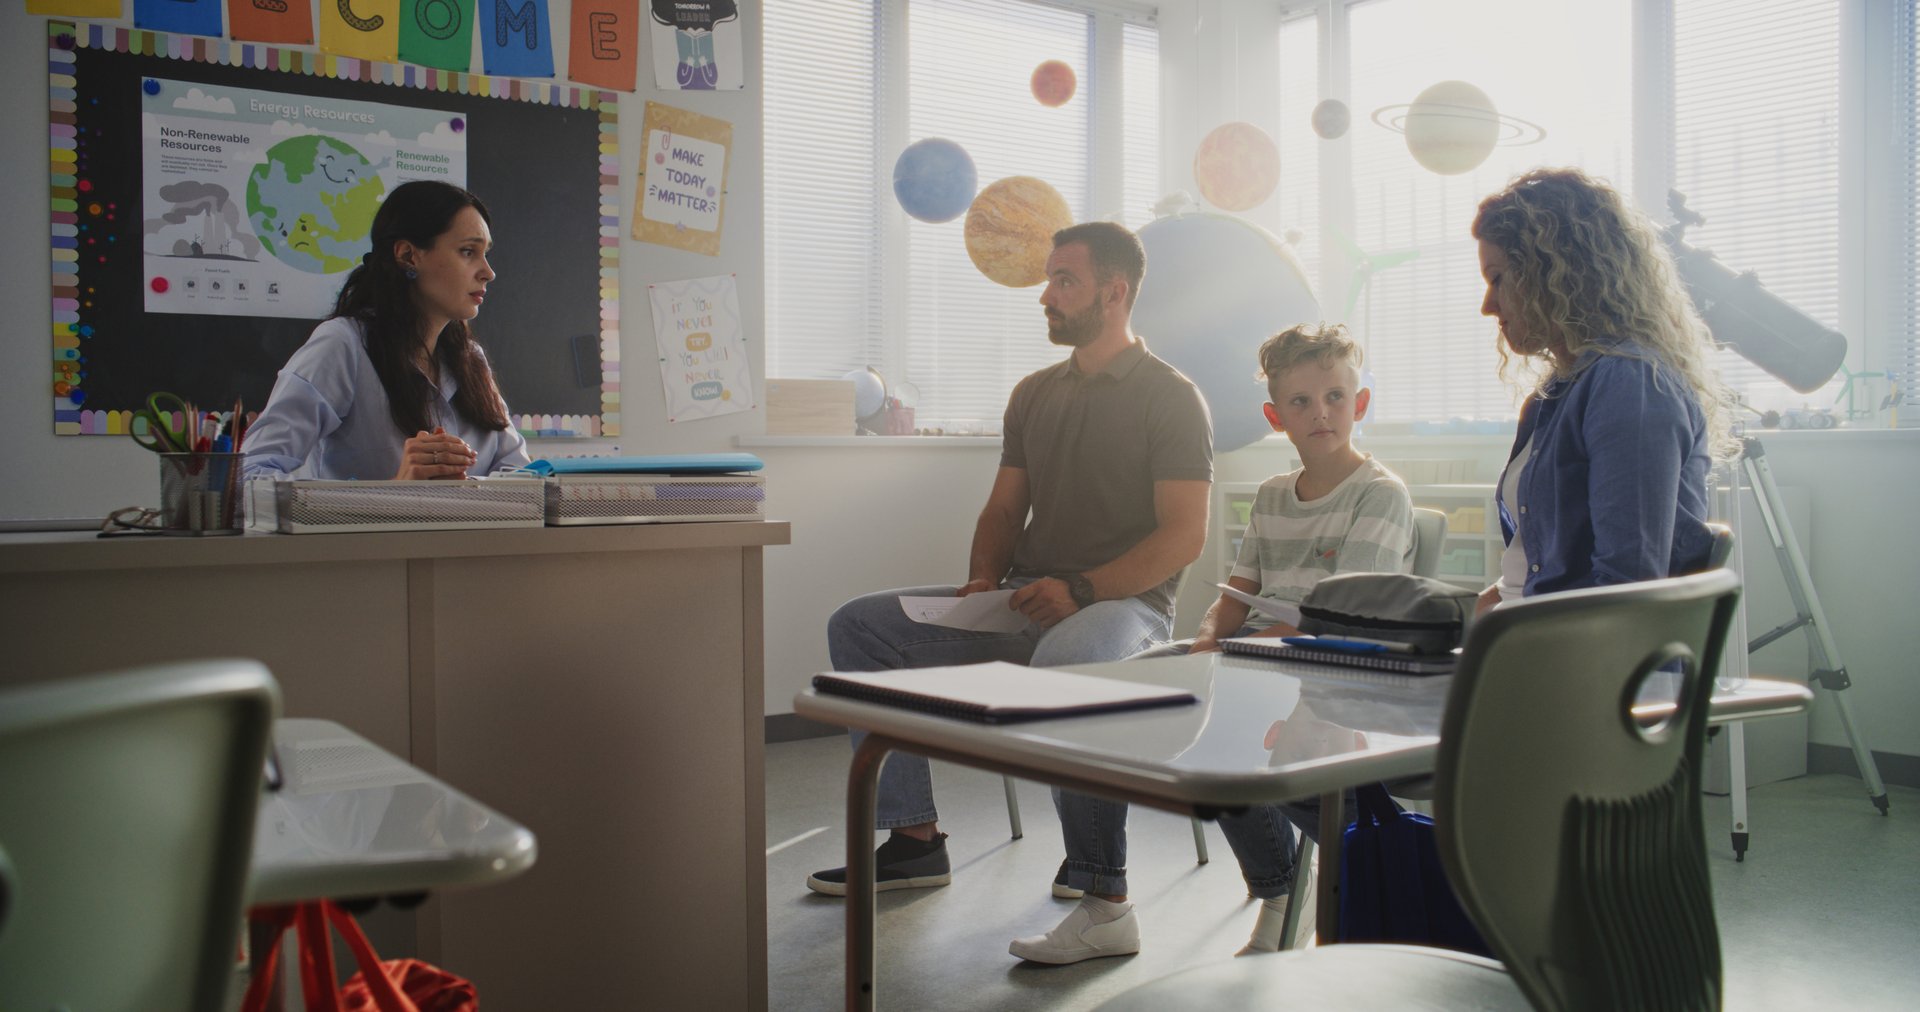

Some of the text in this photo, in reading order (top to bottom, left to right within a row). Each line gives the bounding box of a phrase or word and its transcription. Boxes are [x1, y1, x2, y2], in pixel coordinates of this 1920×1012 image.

[249, 98, 376, 124] Energy Resources
[160, 126, 251, 145] Non-Renewable
[160, 138, 223, 154] Resources
[396, 149, 450, 164] Renewable
[672, 148, 705, 167] MAKE
[396, 160, 449, 175] Resources
[665, 167, 707, 189] TODAY
[658, 189, 708, 213] MATTER
